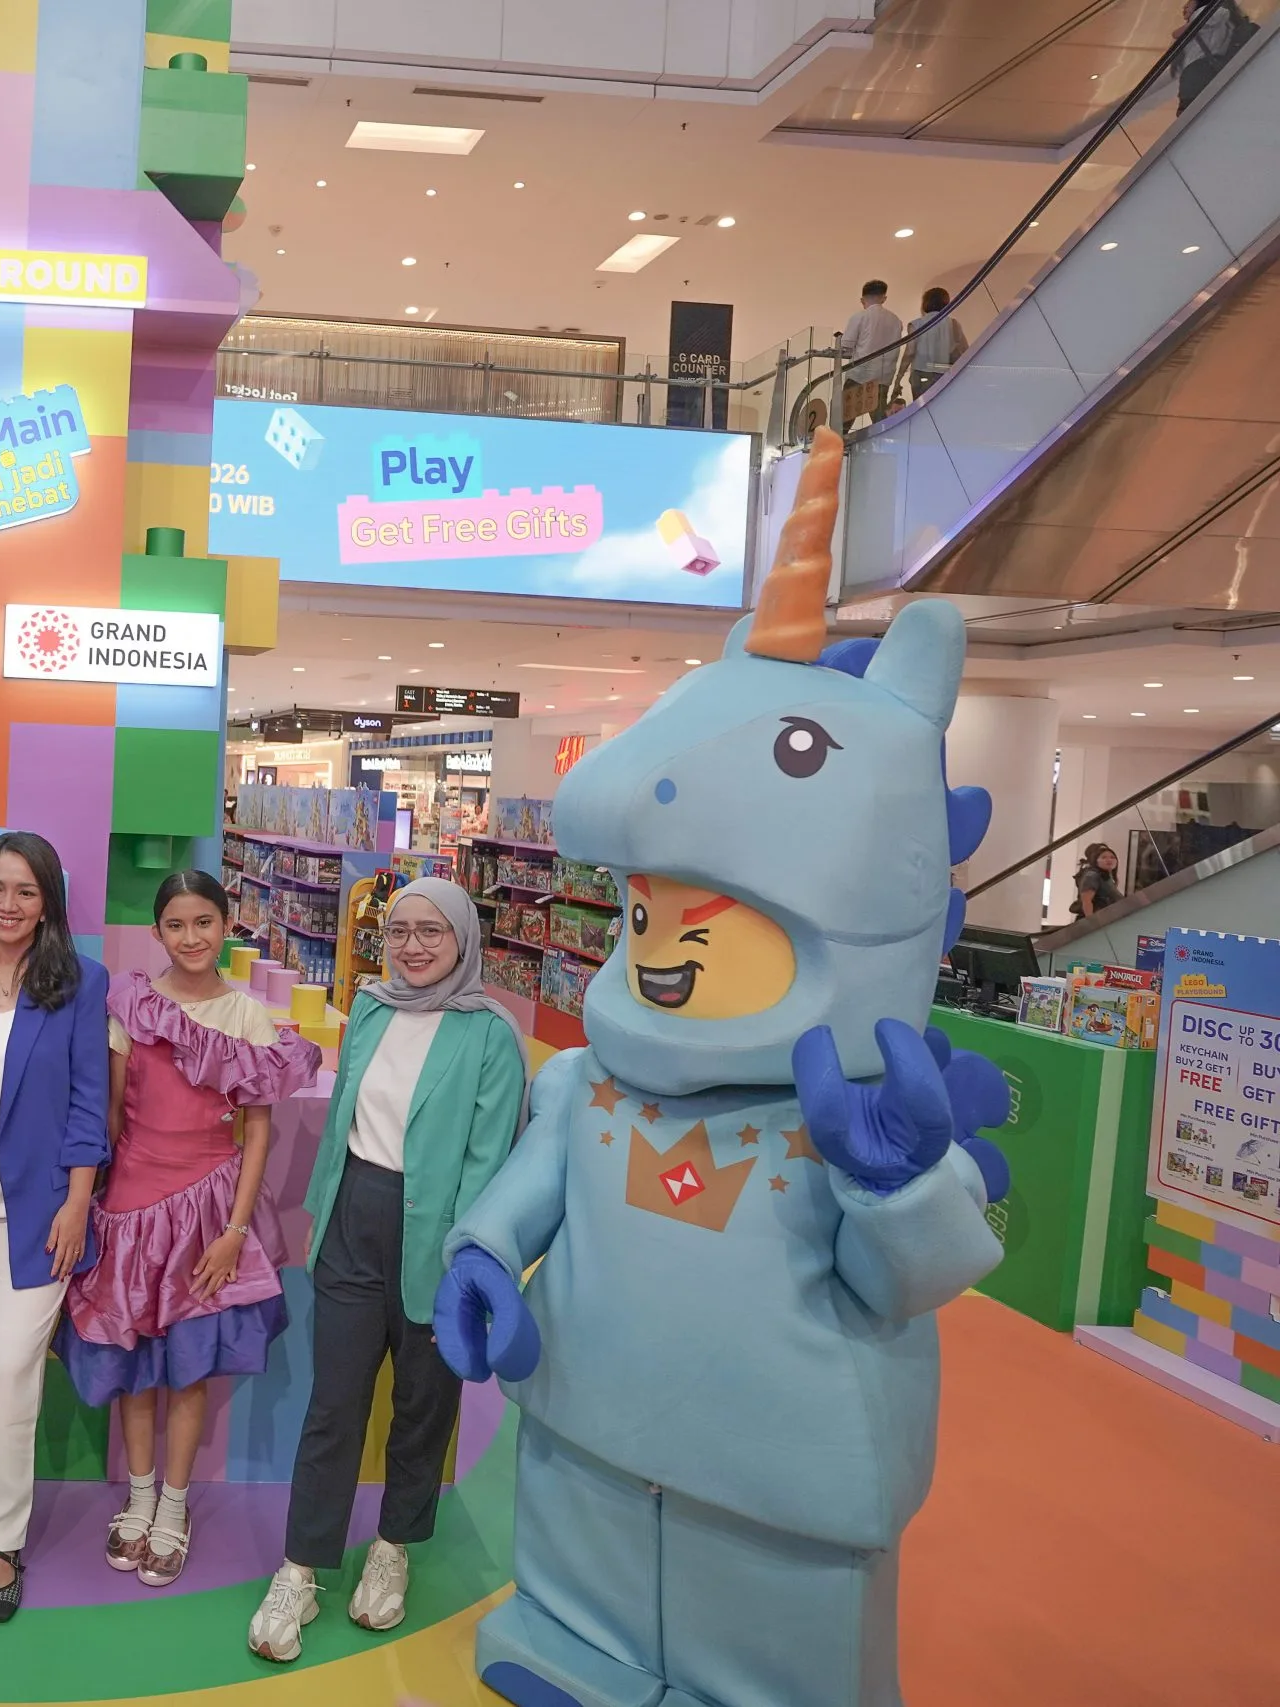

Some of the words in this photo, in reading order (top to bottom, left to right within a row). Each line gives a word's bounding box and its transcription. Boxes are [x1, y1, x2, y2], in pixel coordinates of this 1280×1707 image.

[679, 353, 687, 363] G
[690, 354, 721, 365] CARD
[672, 362, 727, 376] COUNTER
[11, 450, 65, 494] jadi
[381, 446, 474, 493] Play
[227, 494, 276, 516] WIB
[351, 517, 414, 547] Get
[422, 513, 498, 544] Free
[506, 506, 588, 540] Gifts
[91, 621, 166, 642] GRAND
[89, 647, 207, 671] INDONESIA
[353, 716, 381, 729] dyson
[1191, 956, 1225, 966] INDONESIA
[1192, 949, 1214, 958] GRAND
[1109, 970, 1143, 985] NINJAGO
[1182, 1014, 1233, 1041] DISC
[1239, 1025, 1254, 1036] UP
[1239, 1035, 1254, 1047] TO
[1180, 1043, 1229, 1061] KEYCHAIN
[1175, 1056, 1195, 1068] BUY
[1196, 1060, 1203, 1069] 2
[1205, 1063, 1224, 1074] GET
[1226, 1066, 1231, 1076] 1
[1180, 1069, 1223, 1092] FREE
[1243, 1085, 1276, 1104] GET
[1194, 1099, 1235, 1122] FREE
